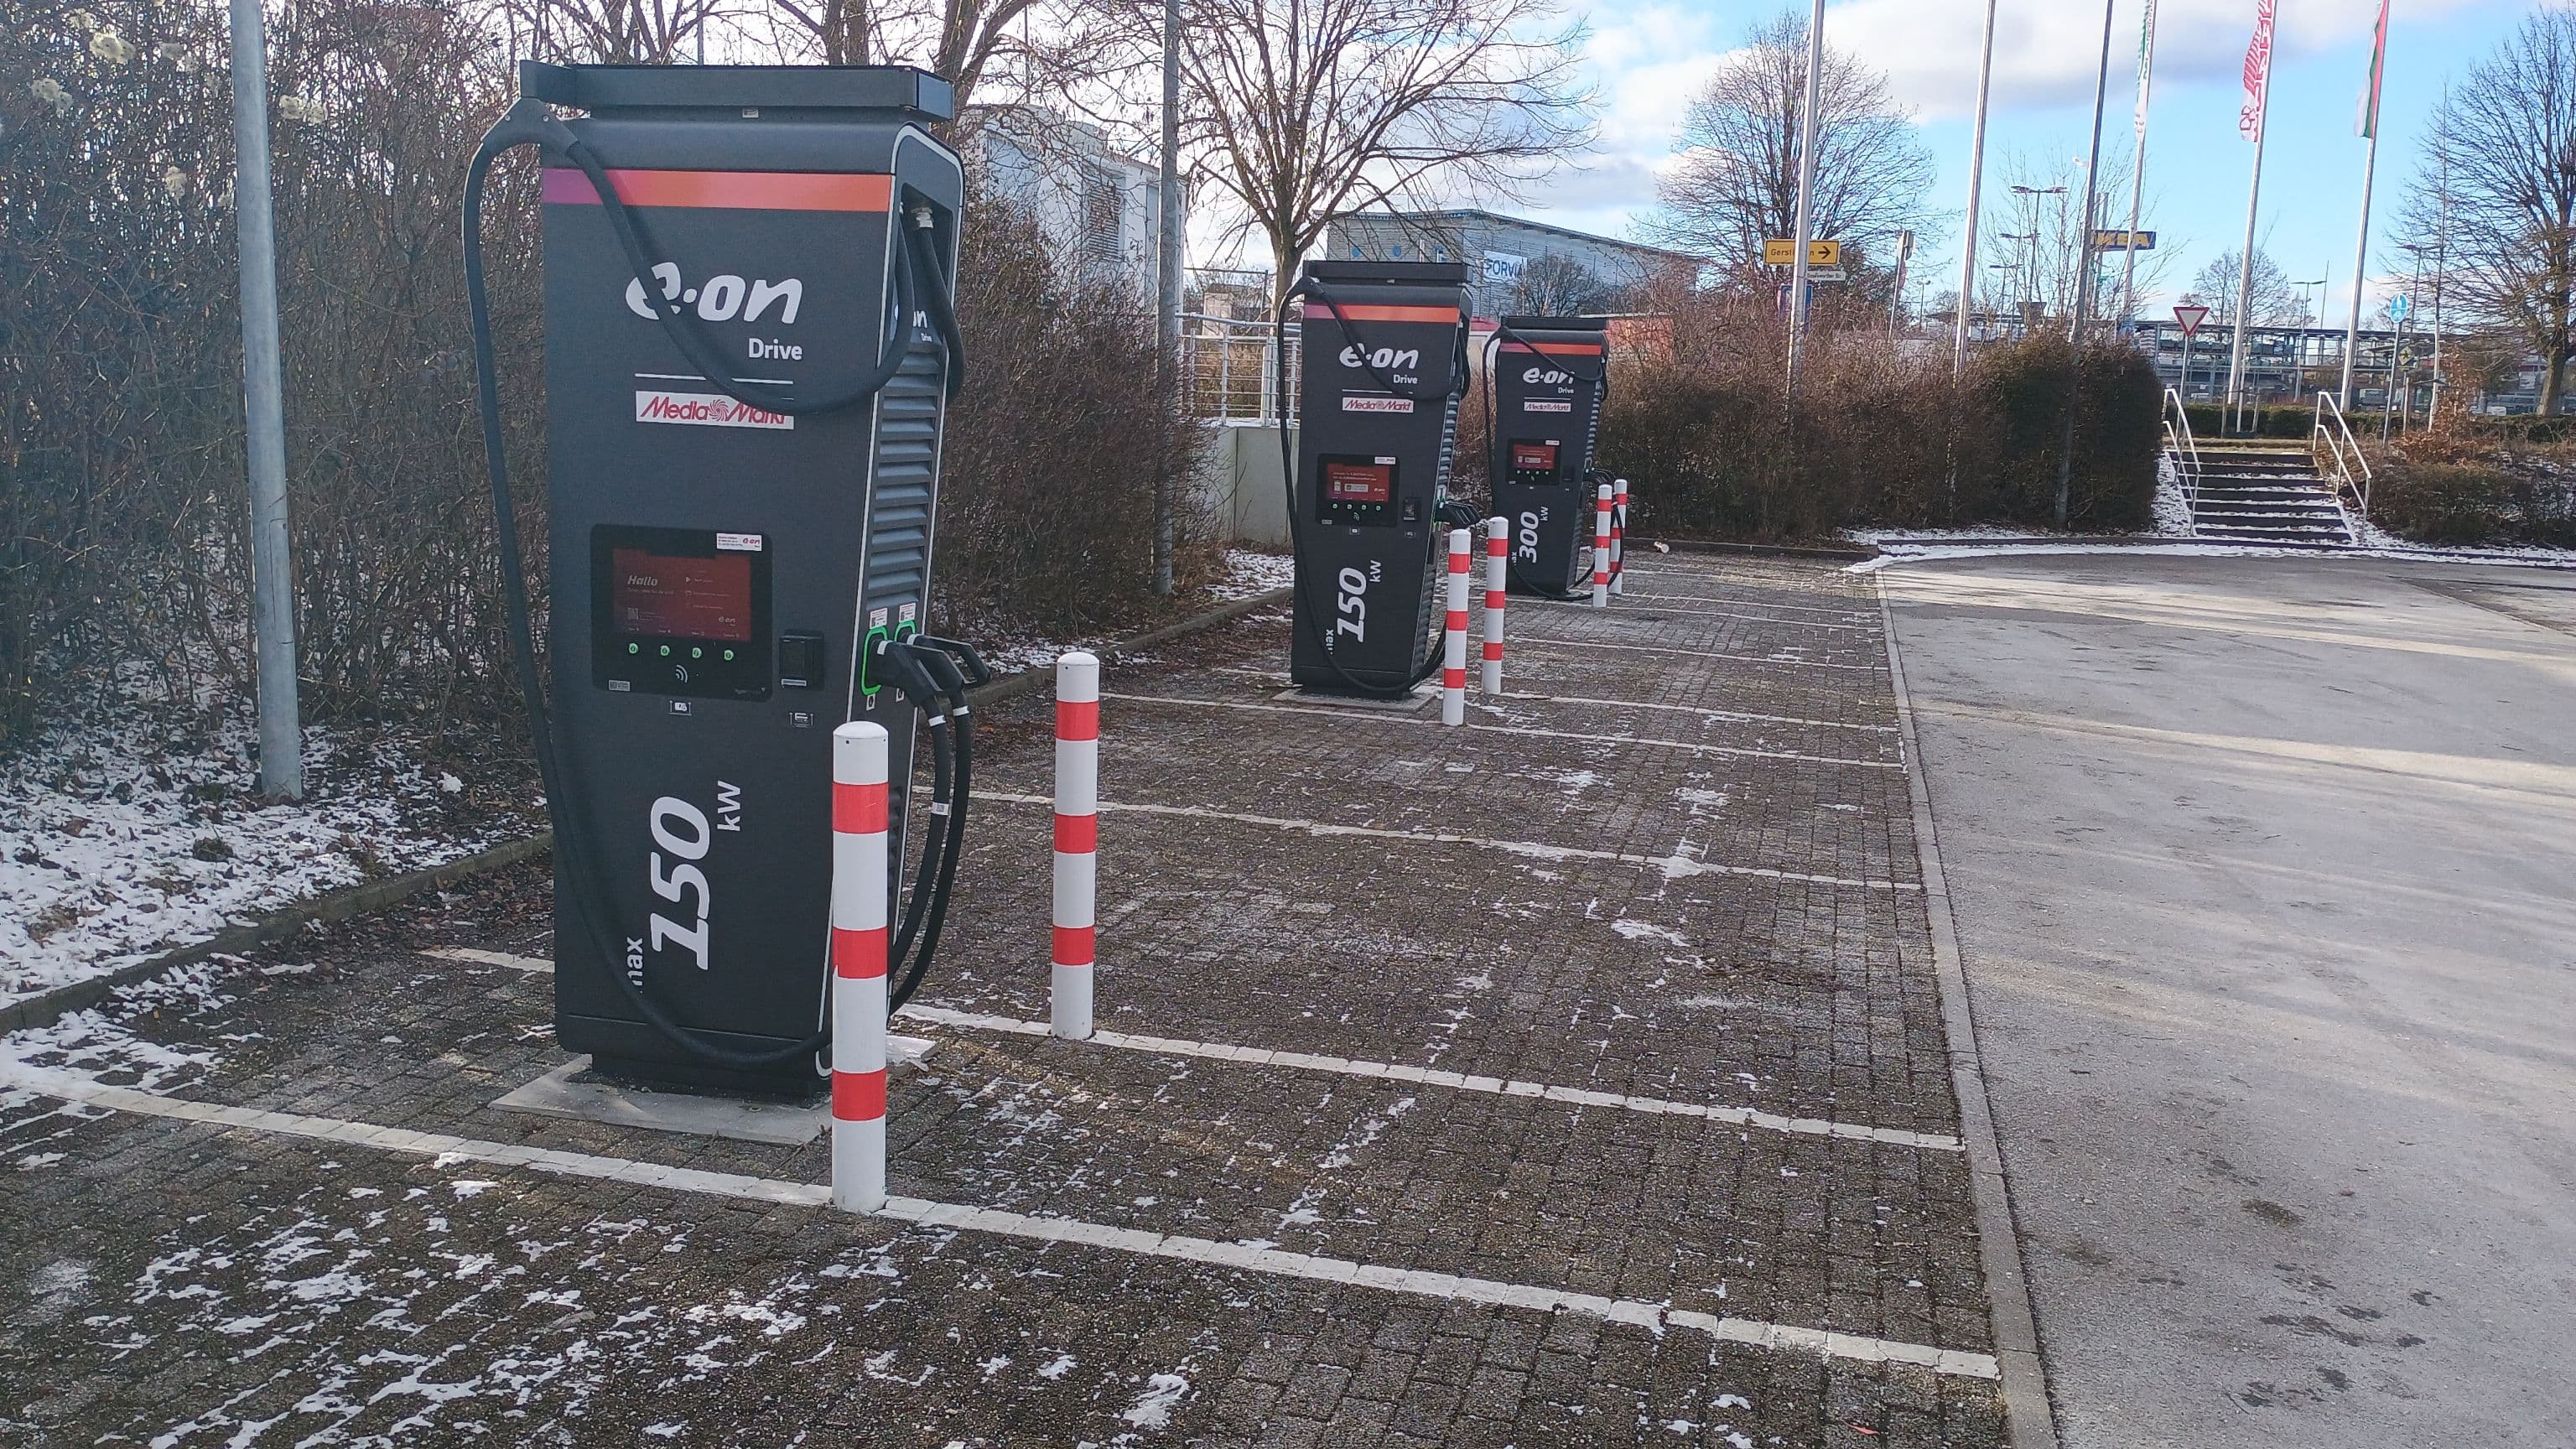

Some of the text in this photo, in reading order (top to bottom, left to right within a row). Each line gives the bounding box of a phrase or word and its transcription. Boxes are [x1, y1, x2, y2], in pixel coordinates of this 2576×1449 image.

[1770, 247, 1815, 257] Gerstn
[748, 338, 802, 361] Drive
[1393, 374, 1418, 384] Drive
[641, 396, 710, 421] Media
[1345, 400, 1376, 410] Media
[1519, 511, 1539, 564] 300
[1540, 506, 1549, 522] kW
[627, 574, 658, 587] Hallo
[1337, 567, 1367, 642] 150
[1368, 559, 1382, 583] kW
[650, 796, 710, 971] 150
[717, 781, 741, 832] kW
